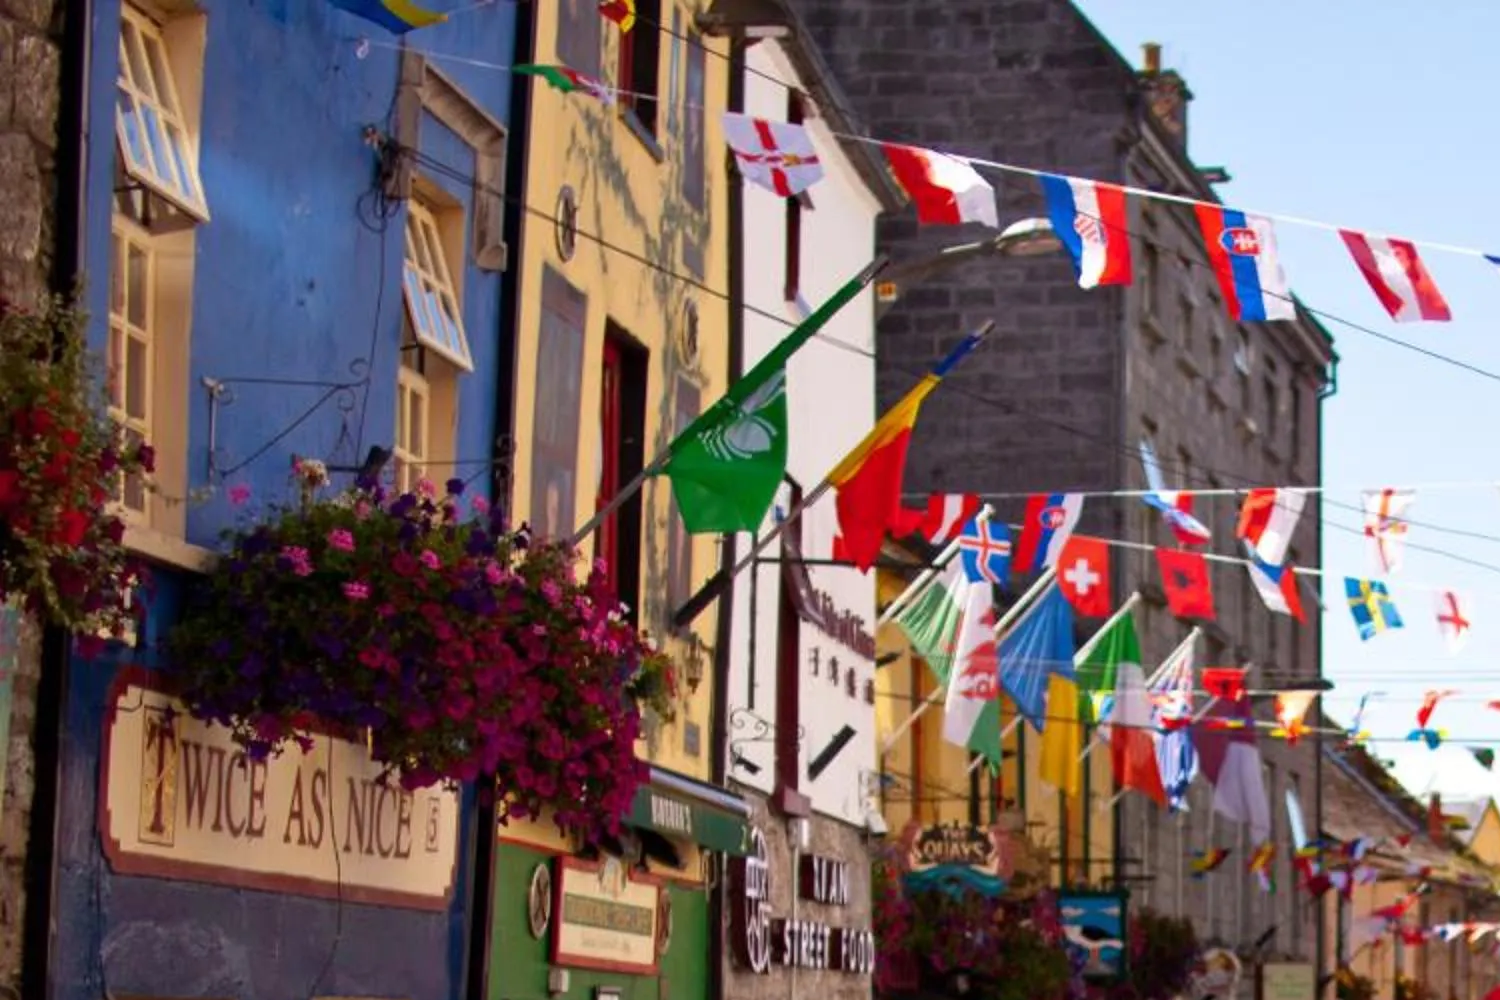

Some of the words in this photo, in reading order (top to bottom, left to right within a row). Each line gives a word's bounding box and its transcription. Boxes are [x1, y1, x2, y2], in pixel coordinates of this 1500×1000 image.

[146, 713, 267, 838] TWICE
[283, 765, 327, 849] AS
[343, 777, 415, 858] NICE
[923, 841, 986, 860] QUAYS
[783, 920, 830, 968] STREET
[842, 929, 875, 973] FOOD
